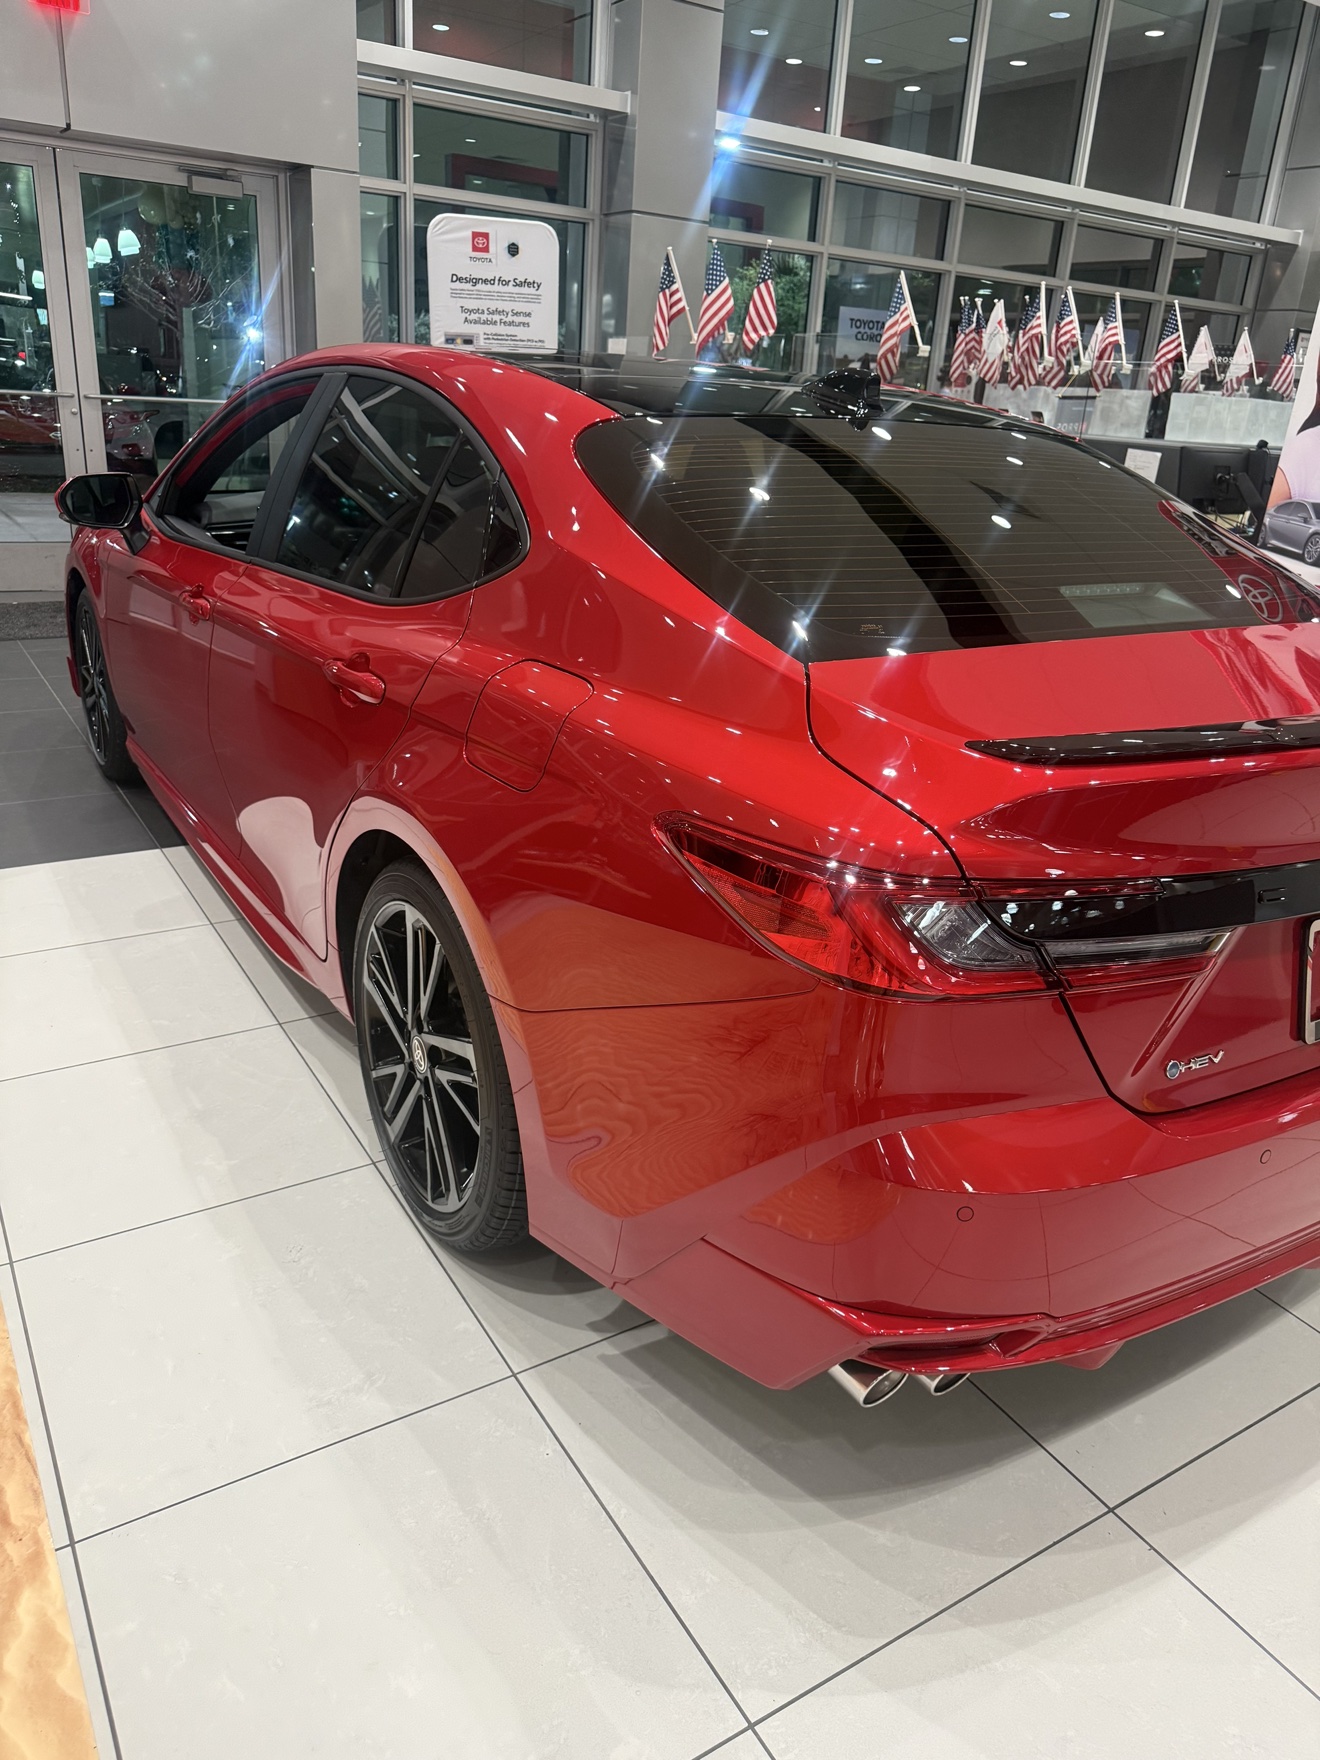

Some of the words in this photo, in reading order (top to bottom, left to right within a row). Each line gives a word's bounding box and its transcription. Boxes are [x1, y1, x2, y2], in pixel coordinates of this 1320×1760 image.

[469, 256, 493, 264] TOYOTA
[450, 273, 496, 287] Designed
[497, 276, 511, 287] for
[512, 277, 542, 291] Safety
[459, 306, 485, 316] Toyota
[486, 307, 509, 318] Safety
[510, 308, 532, 318] Sense
[463, 317, 498, 326] Available
[499, 318, 530, 328] Features
[855, 331, 882, 343] CORO
[1180, 1050, 1225, 1073] HEV
